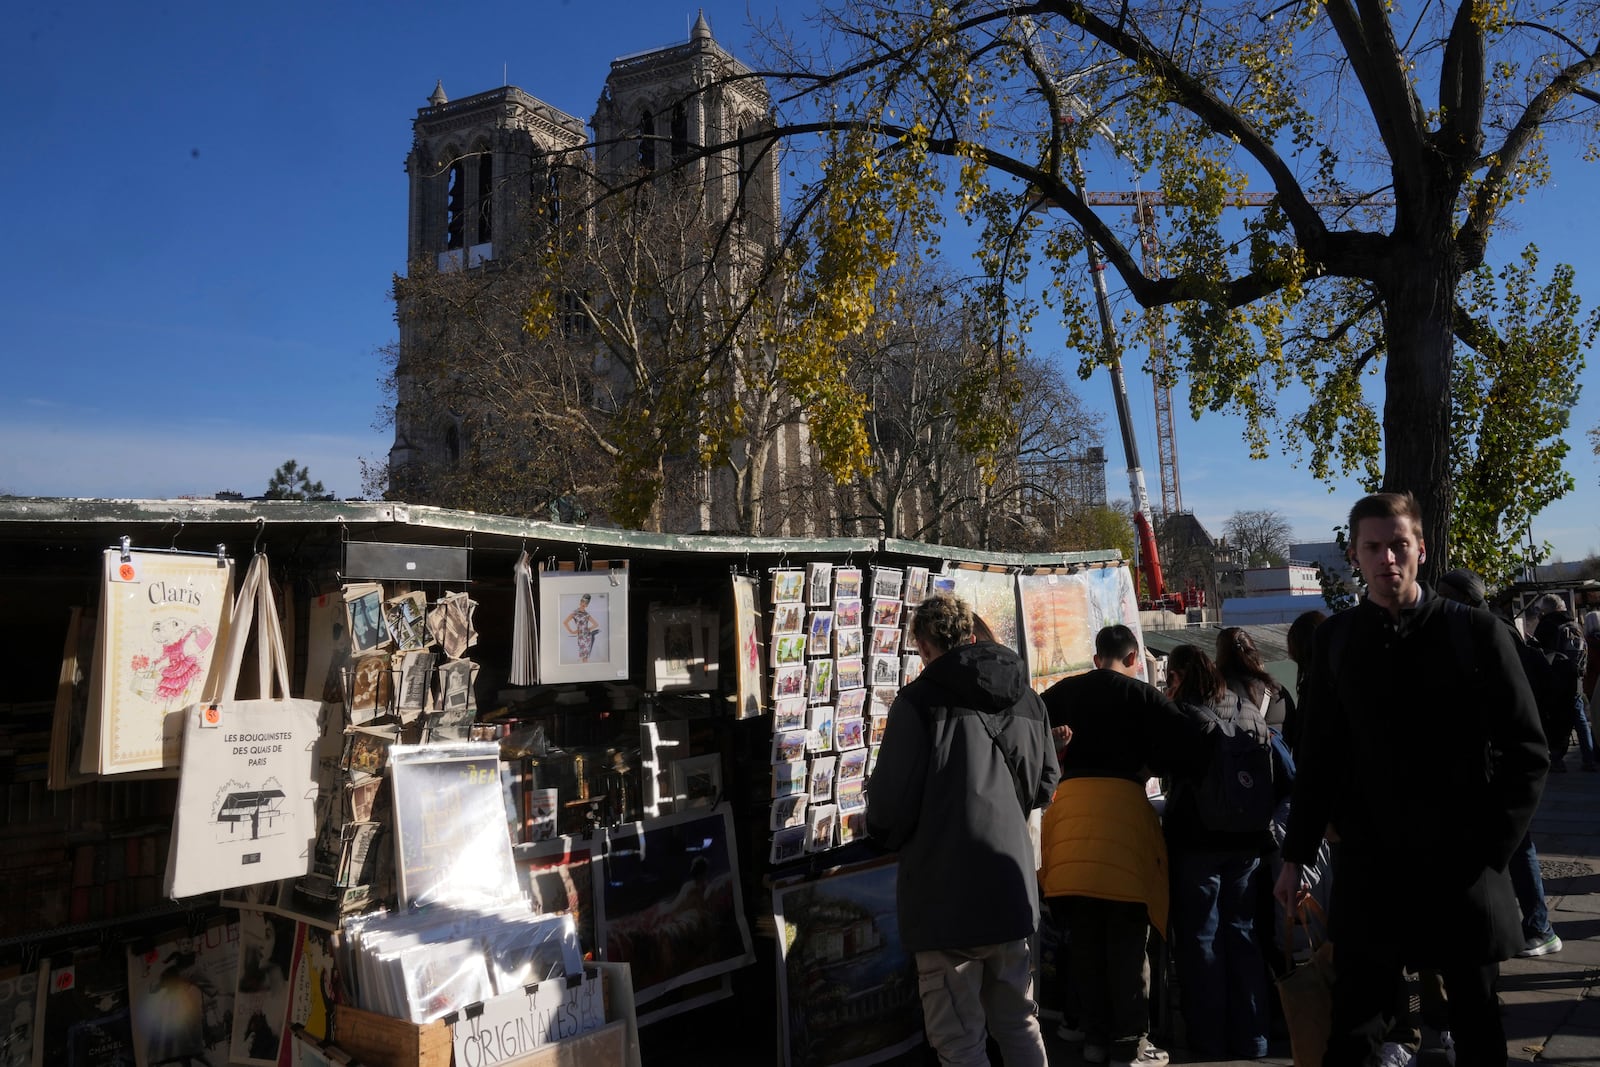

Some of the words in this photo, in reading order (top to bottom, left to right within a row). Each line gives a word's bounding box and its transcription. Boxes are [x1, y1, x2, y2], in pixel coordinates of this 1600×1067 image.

[148, 581, 202, 606] Claris
[224, 734, 238, 743] LES
[239, 732, 292, 742] BOUQUINISTES
[232, 746, 248, 755] DES
[250, 745, 271, 755] QUAIS
[272, 745, 283, 753] DE
[248, 758, 267, 767] PARIS
[464, 1003, 578, 1067] ORIGINALES
